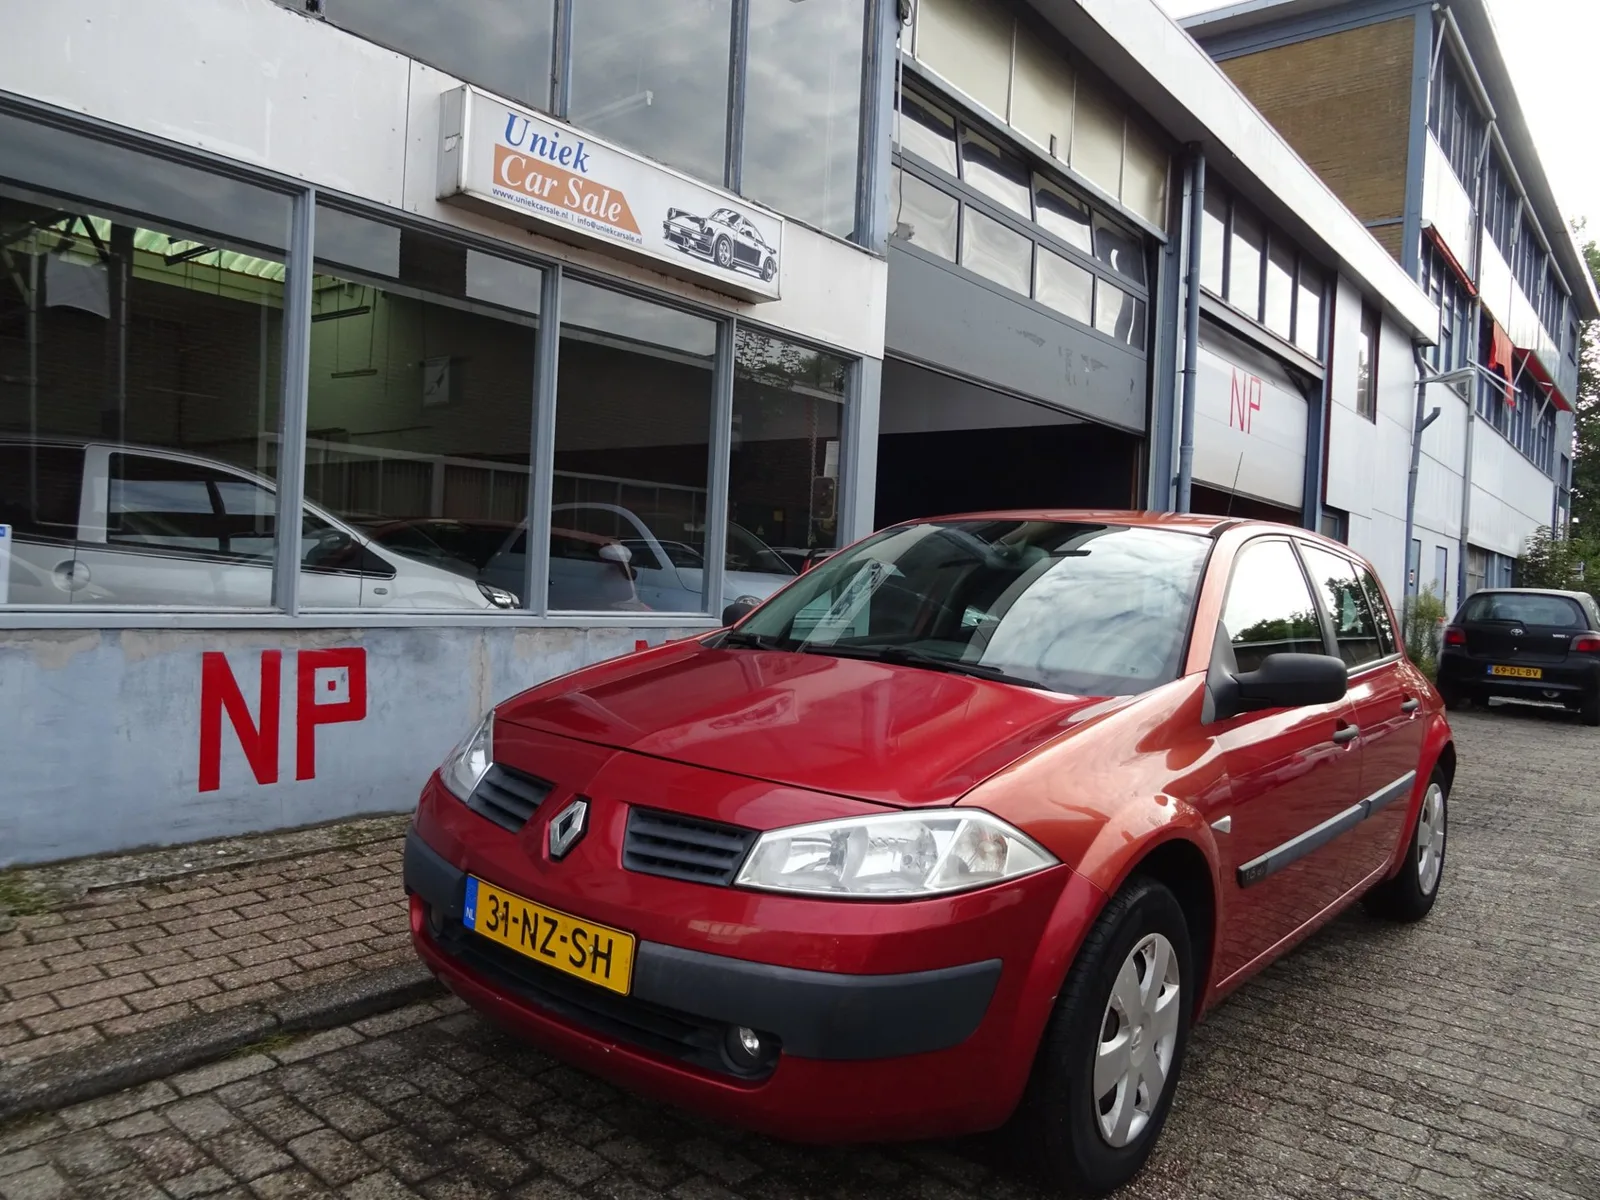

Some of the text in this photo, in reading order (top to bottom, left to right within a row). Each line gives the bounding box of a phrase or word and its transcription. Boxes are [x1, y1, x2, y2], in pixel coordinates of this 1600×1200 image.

[505, 112, 590, 173] Uniek
[492, 187, 569, 219] www.uniekcarsale.nl
[577, 217, 643, 244] info@uniekcarsale.nl
[501, 154, 622, 223] Car Sale
[1229, 366, 1262, 434] NP
[1494, 666, 1539, 677] 69-DL-BV
[198, 647, 367, 792] NP
[465, 894, 613, 979] NL 31-NZ-SH
